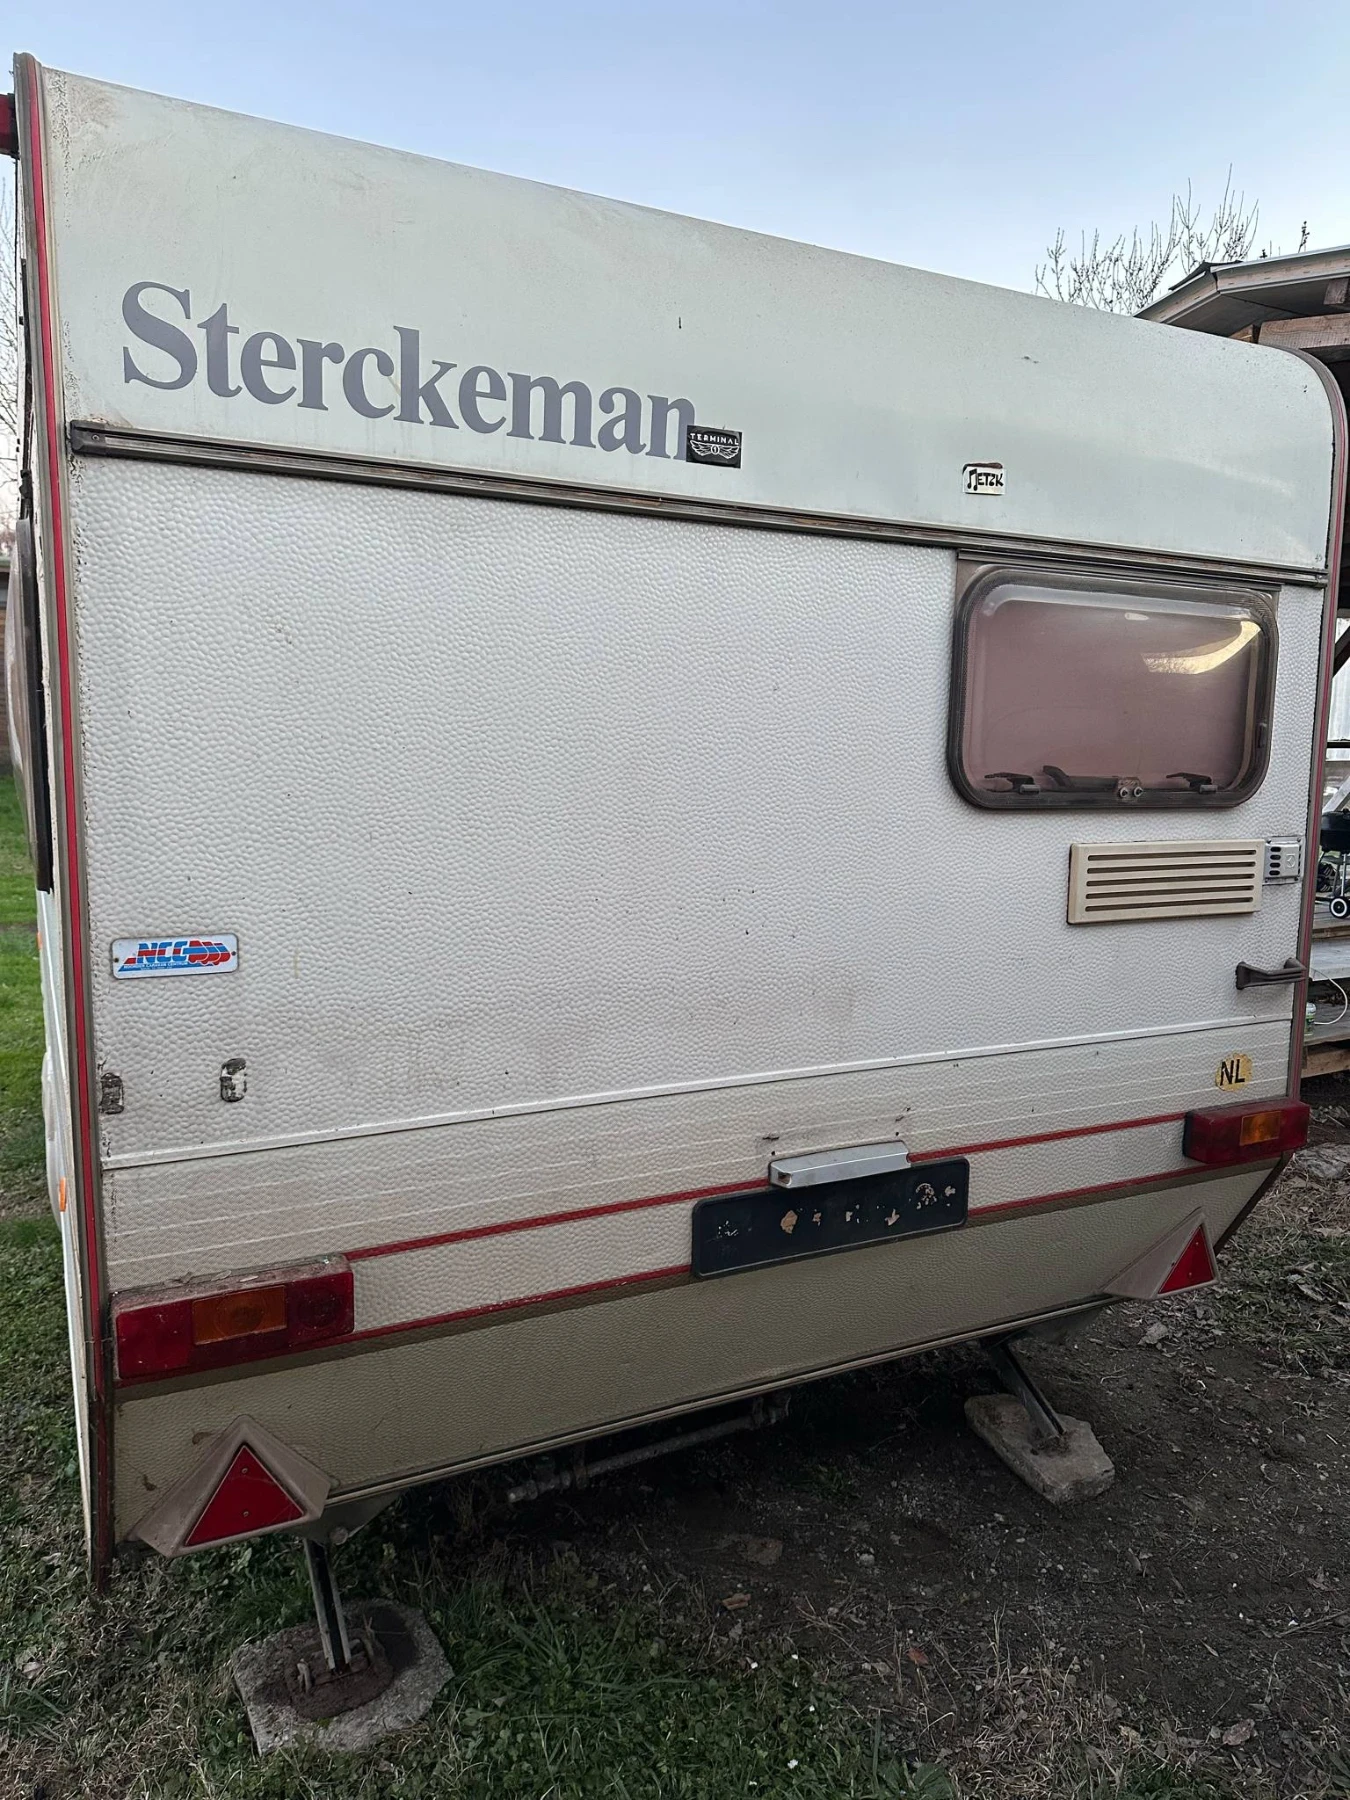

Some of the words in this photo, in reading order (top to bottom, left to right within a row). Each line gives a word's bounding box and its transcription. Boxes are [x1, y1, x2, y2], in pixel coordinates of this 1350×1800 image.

[122, 281, 695, 461] Sterckeman
[689, 433, 739, 445] TERMINAL
[137, 941, 188, 963] NCC
[1219, 1058, 1246, 1087] NL
